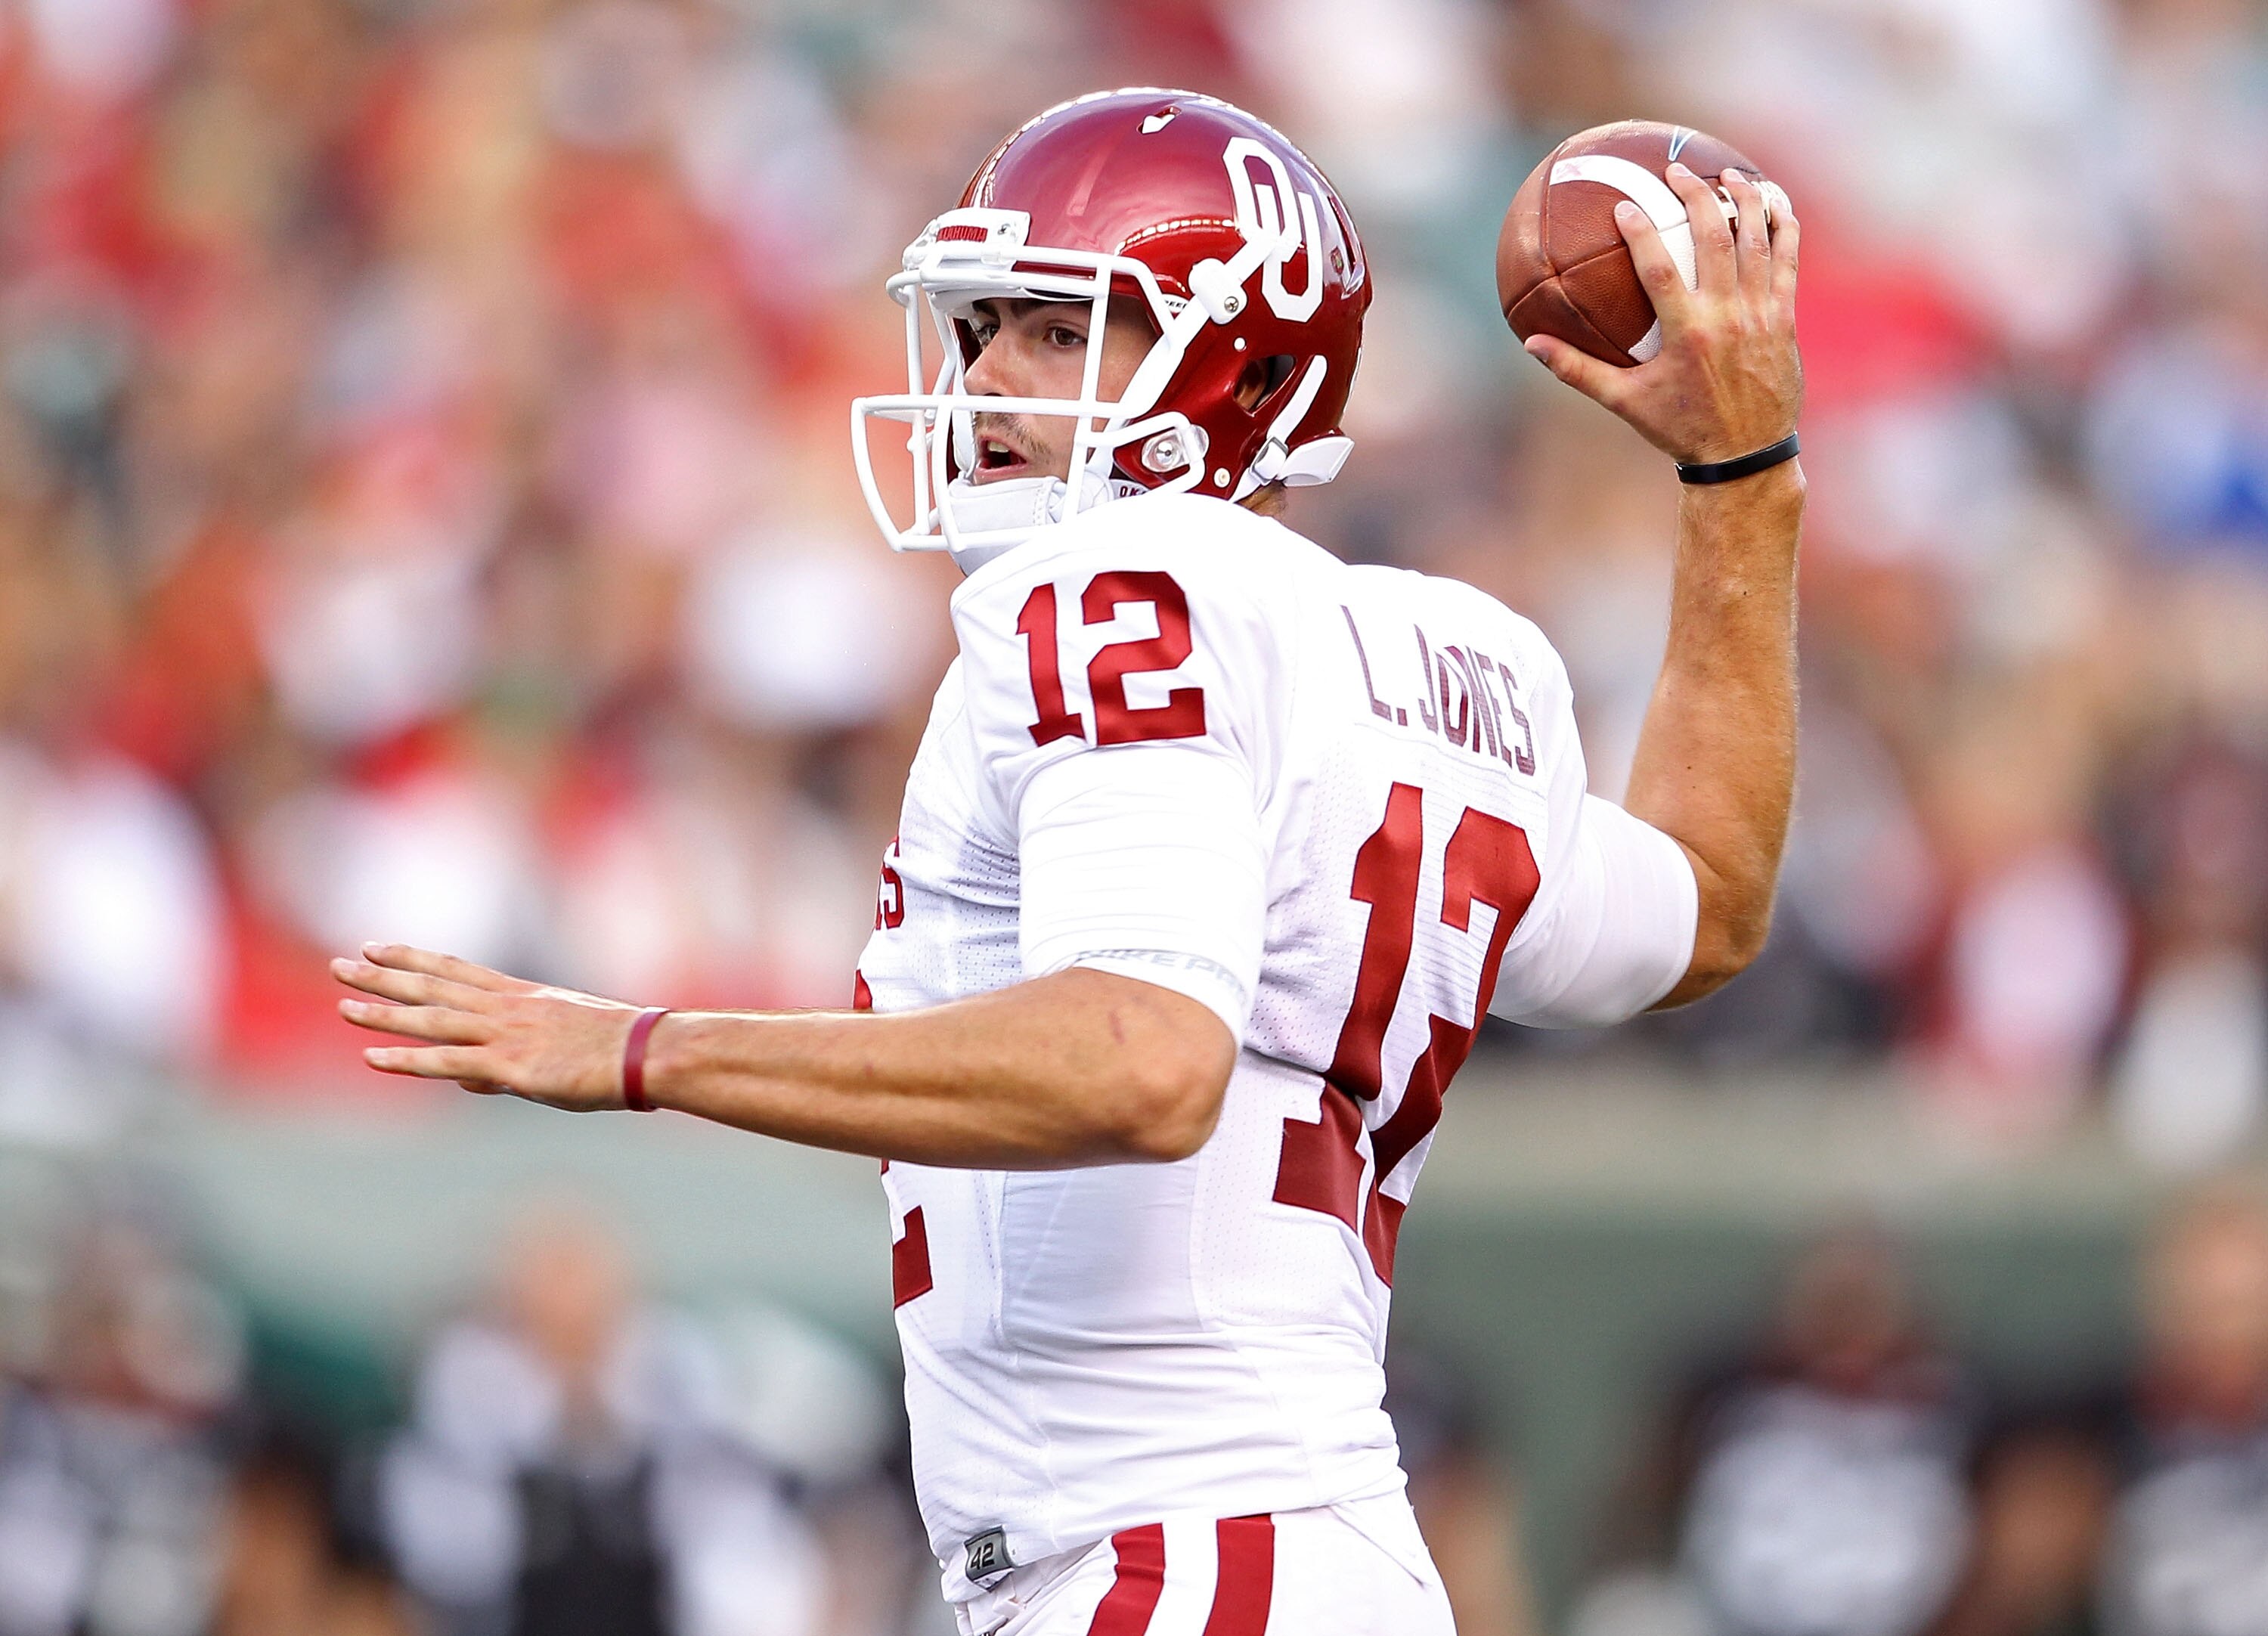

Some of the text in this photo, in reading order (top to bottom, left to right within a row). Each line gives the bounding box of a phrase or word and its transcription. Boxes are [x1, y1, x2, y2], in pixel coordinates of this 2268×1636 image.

[1222, 137, 1324, 324] OU
[1015, 571, 1207, 747] 12
[1272, 781, 1541, 1290] 12
[970, 1541, 996, 1571] 42
